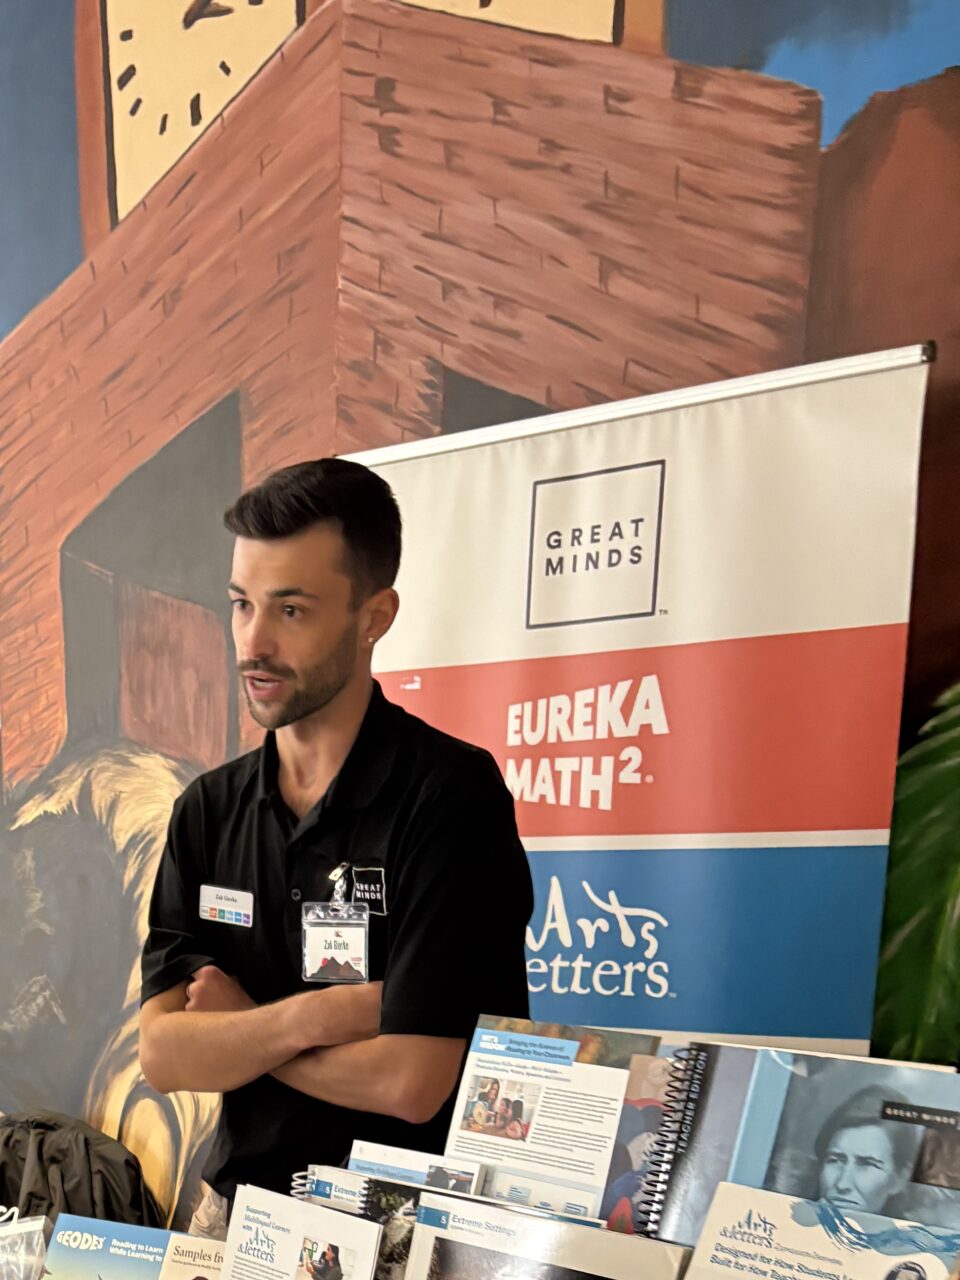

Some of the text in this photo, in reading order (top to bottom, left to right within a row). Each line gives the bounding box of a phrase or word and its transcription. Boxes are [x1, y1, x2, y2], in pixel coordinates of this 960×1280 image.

[546, 518, 644, 549] GREAT
[545, 546, 643, 576] MINDS
[506, 674, 669, 747] EUREKA
[355, 890, 382, 900] MINDS
[525, 875, 669, 959] Arts
[677, 1051, 709, 1153] TEACHER EDITION
[452, 1214, 483, 1229] Extreme
[737, 1208, 778, 1237] Arts
[56, 1230, 105, 1250] GEODES
[111, 1239, 164, 1254] Reading to Learn
[248, 1226, 277, 1250] Arts
[109, 1246, 127, 1256] While
[127, 1249, 155, 1262] Learning
[173, 1245, 224, 1264] Samples fr
